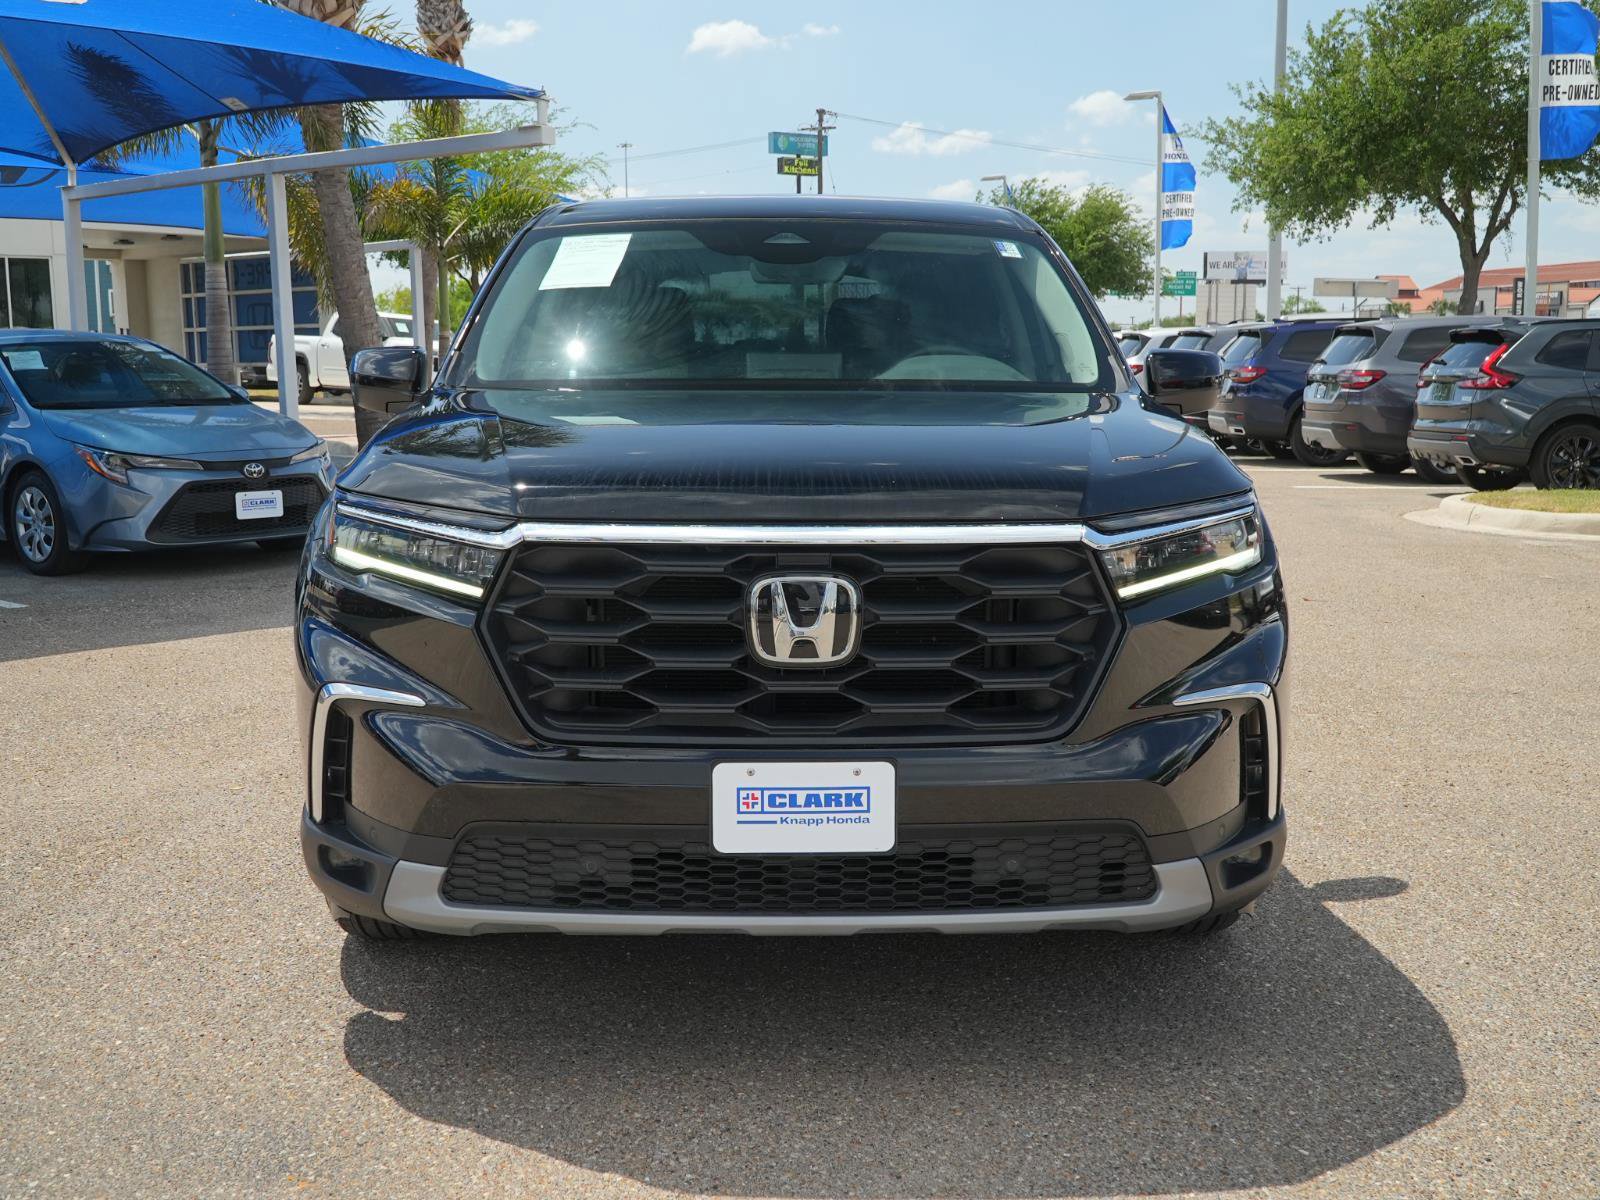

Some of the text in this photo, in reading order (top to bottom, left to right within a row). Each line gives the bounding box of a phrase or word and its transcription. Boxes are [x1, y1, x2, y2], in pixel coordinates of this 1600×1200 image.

[1542, 84, 1600, 101] PRE-OWNED
[1165, 193, 1193, 204] CERTIFIED
[1162, 208, 1195, 219] PRE-OWNED
[1209, 261, 1236, 269] WE ARE
[767, 792, 864, 808] CLARK
[780, 816, 870, 826] Knapp Honda
